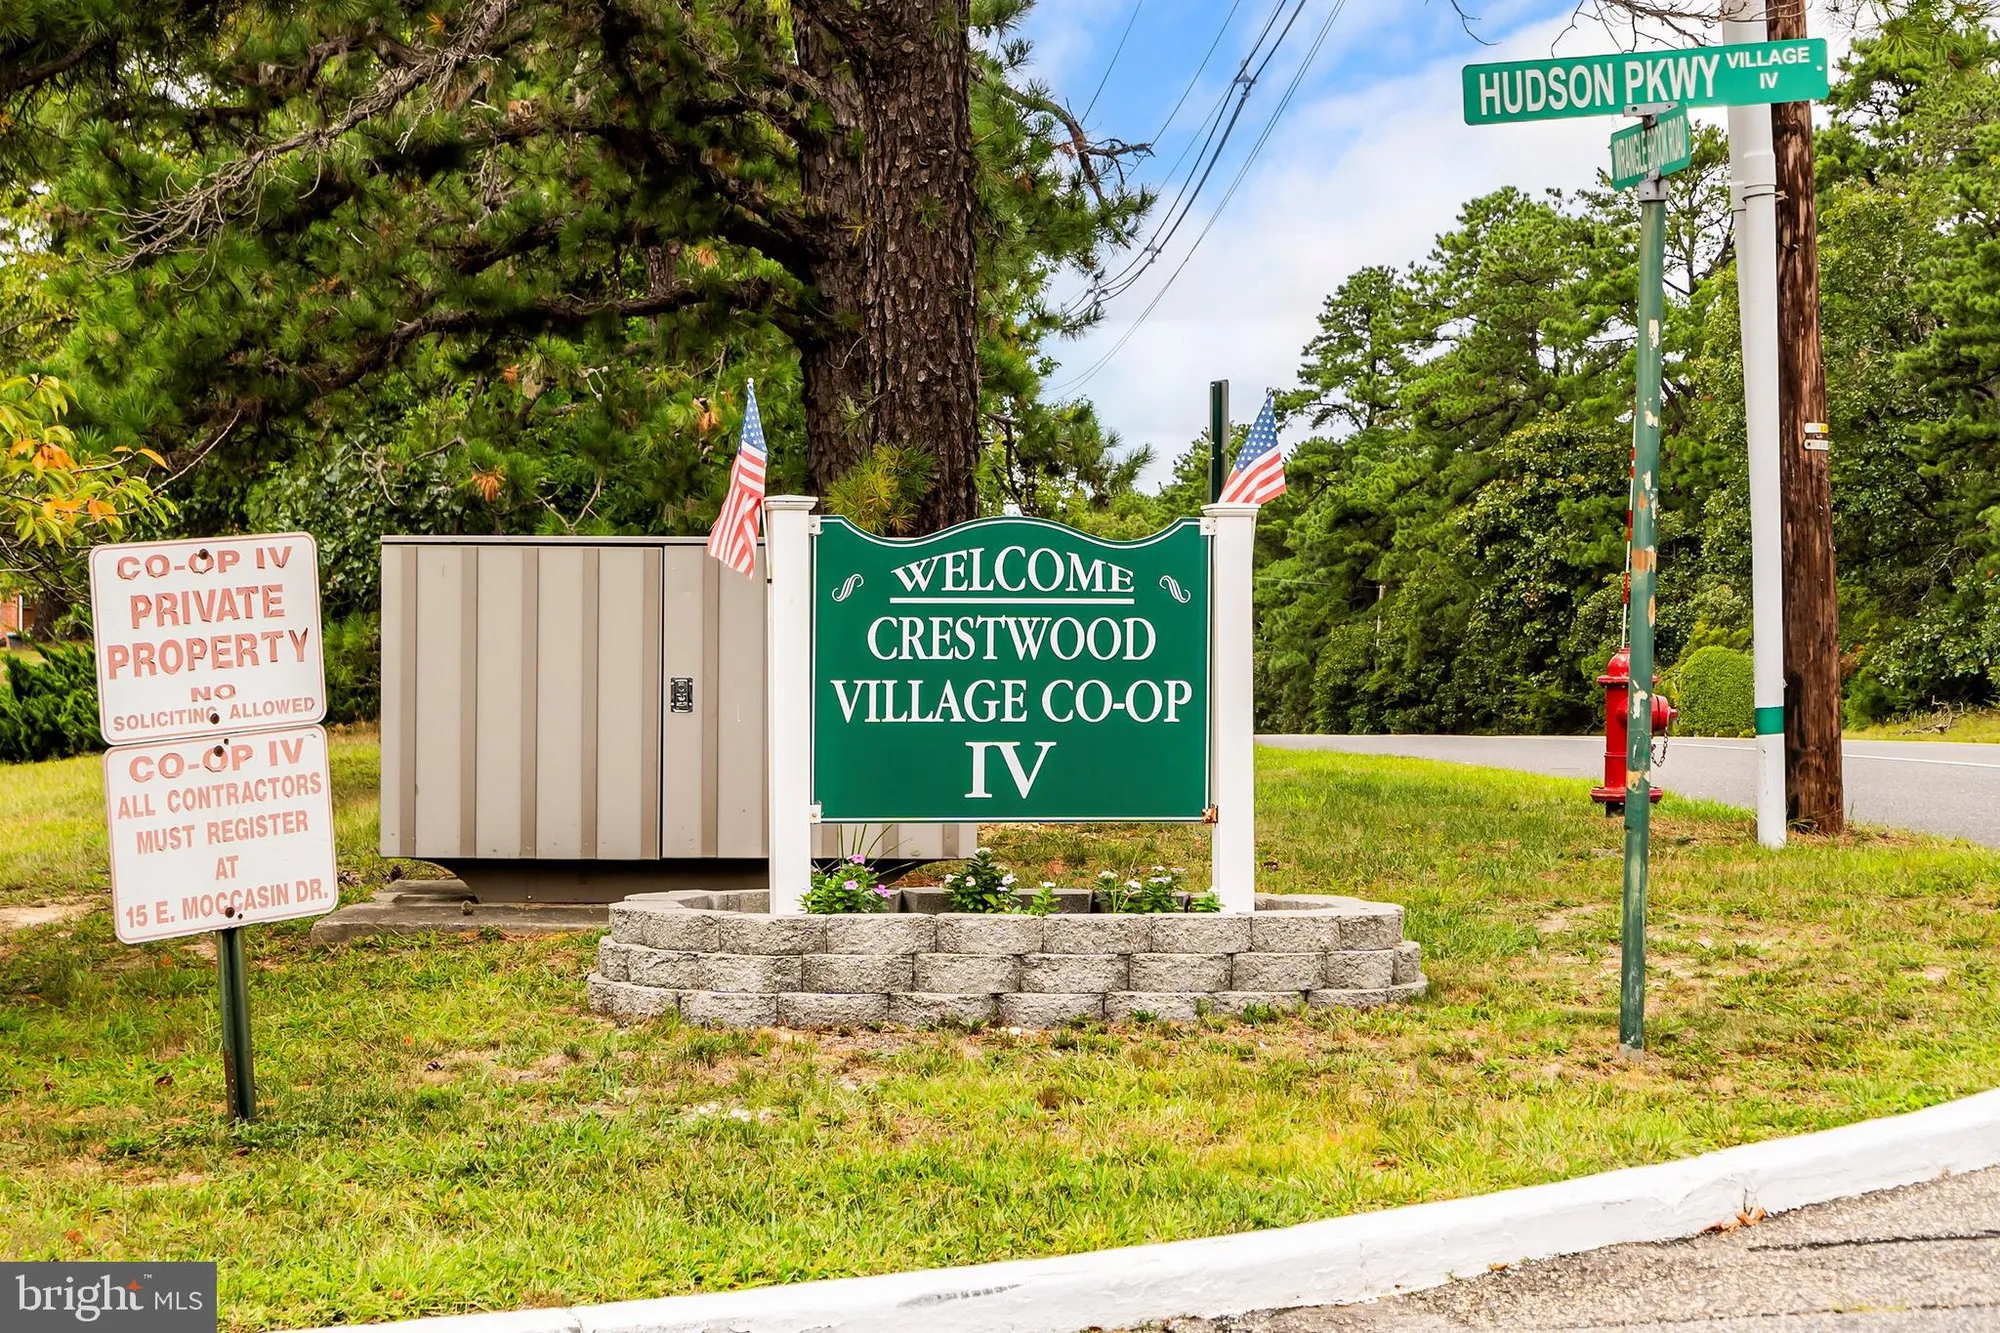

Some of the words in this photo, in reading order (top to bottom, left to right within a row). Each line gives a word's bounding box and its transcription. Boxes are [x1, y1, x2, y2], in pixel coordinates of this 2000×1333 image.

[1726, 46, 1810, 69] VILLAGE
[1479, 63, 1615, 116] HUDSON
[1624, 54, 1719, 104] PKWY
[1759, 72, 1779, 89] IV
[117, 549, 241, 580] CO-OP
[255, 546, 292, 569] IV
[890, 546, 1135, 593] WELCOME
[130, 584, 285, 629] PRIVATE
[107, 627, 309, 680] PROPERTY
[867, 614, 1157, 661] CRESTWOOD
[113, 706, 218, 732] SOLICITING
[229, 696, 315, 720] ALLOWED
[190, 684, 236, 702] NO
[830, 679, 1028, 723] VILLAGE
[1041, 679, 1193, 723] CO-OP
[129, 744, 254, 783] CO-OP
[268, 737, 304, 766] IV
[964, 741, 1057, 799] IV
[117, 794, 156, 819] ALL
[167, 772, 322, 814] CONTRACTORS
[136, 824, 195, 855] MUST
[207, 810, 309, 845] REGISTER
[215, 855, 239, 880] AT
[126, 904, 148, 928] 15
[155, 900, 175, 925] E.
[182, 882, 289, 921] MOCCASIN
[296, 878, 328, 903] DR.
